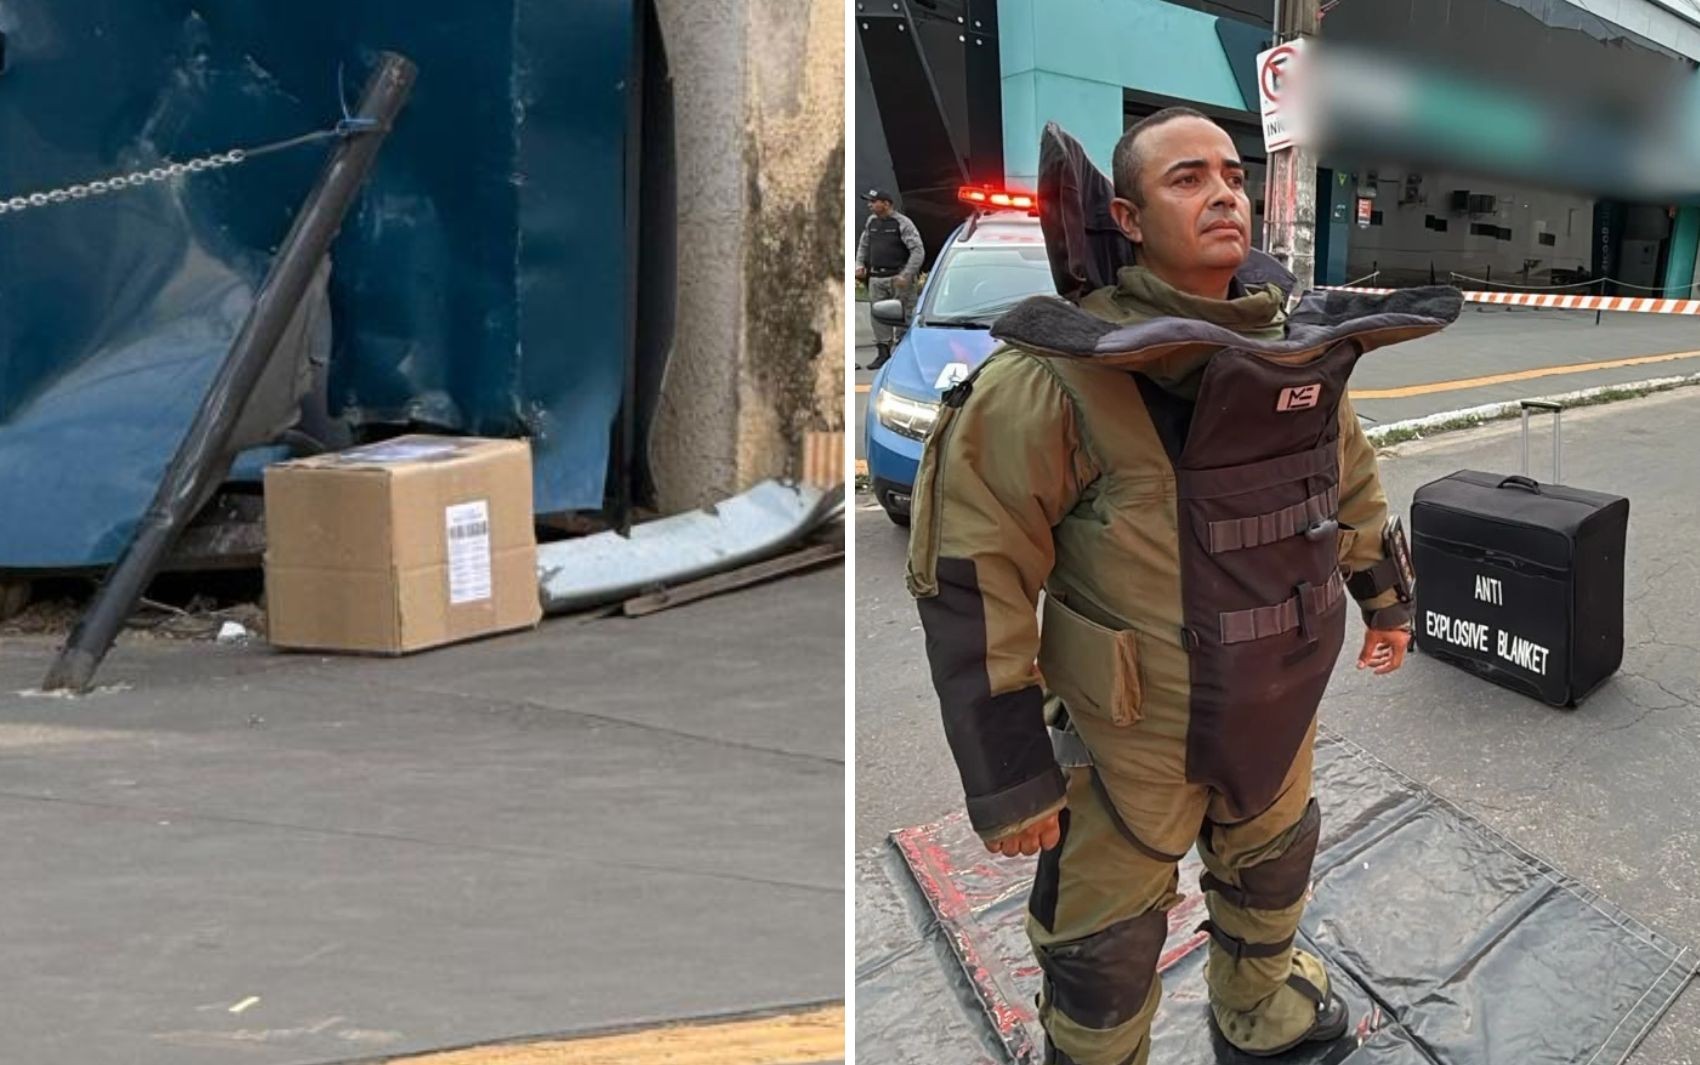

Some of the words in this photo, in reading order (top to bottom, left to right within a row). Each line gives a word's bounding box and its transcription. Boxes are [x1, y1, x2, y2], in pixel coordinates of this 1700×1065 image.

[1475, 574, 1503, 606] ANTI
[1426, 610, 1489, 652] EXPLOSIVE
[1498, 630, 1549, 676] BLANKET
